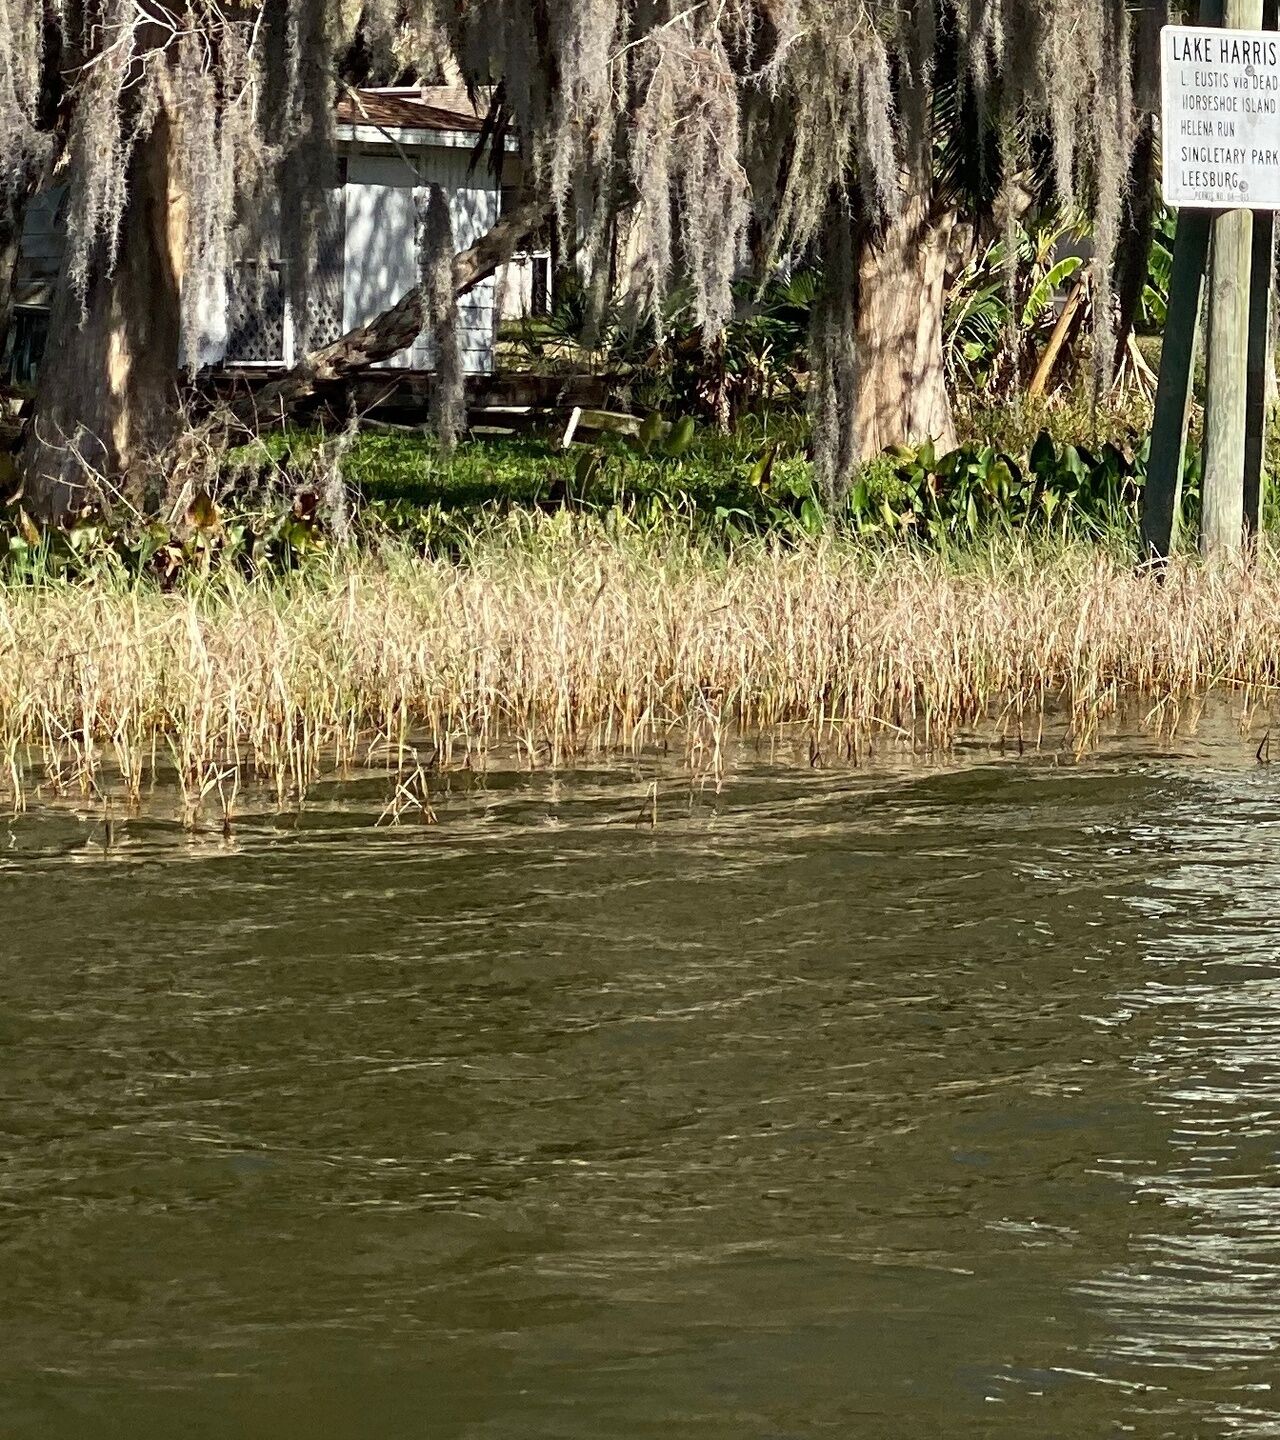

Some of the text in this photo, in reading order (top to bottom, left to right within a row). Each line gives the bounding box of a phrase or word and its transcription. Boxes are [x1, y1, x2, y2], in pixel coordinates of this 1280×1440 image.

[1173, 36, 1212, 63] LAKE
[1219, 38, 1277, 66] HARRIS
[1195, 71, 1229, 88] EUSTIS
[1233, 76, 1249, 90] via
[1252, 74, 1278, 91] DEAD
[1182, 94, 1238, 112] HORSESHOE
[1242, 97, 1276, 114] ISLAND
[1180, 119, 1214, 136] HELENA
[1217, 121, 1235, 137] RUN
[1181, 146, 1246, 164] SINGLETARY
[1251, 149, 1279, 166] PARK
[1182, 170, 1239, 190] LEESBURG
